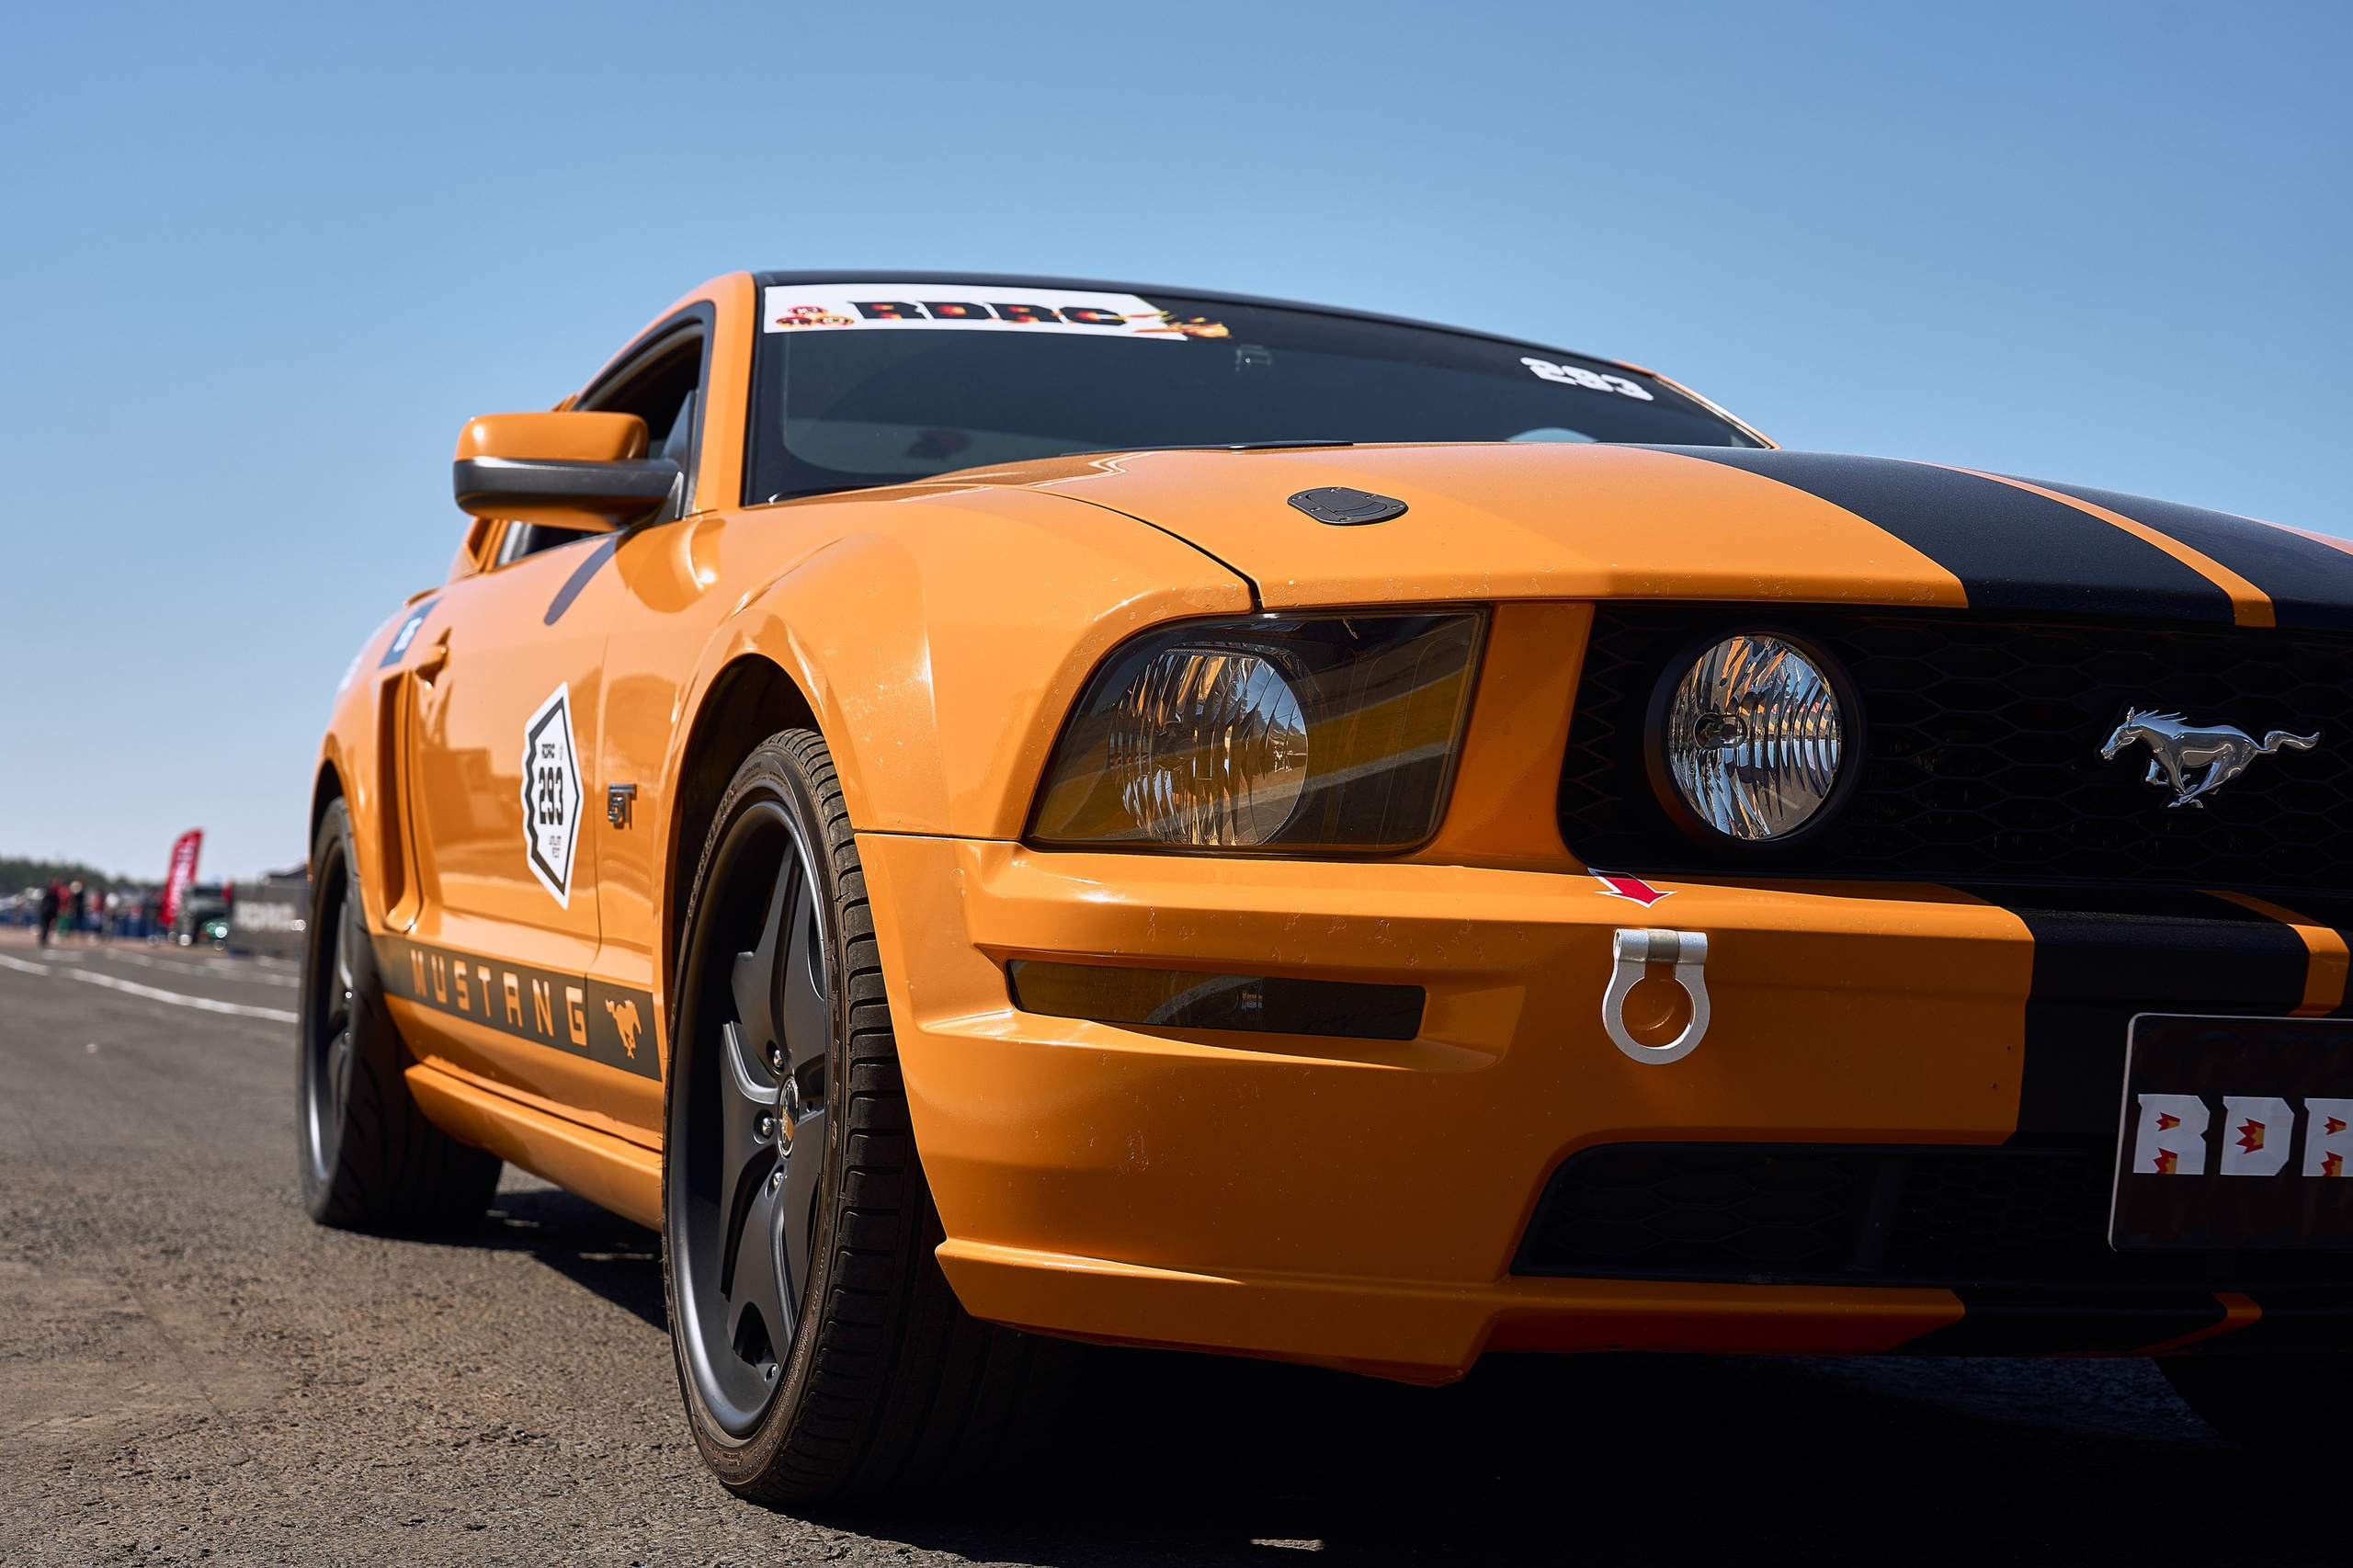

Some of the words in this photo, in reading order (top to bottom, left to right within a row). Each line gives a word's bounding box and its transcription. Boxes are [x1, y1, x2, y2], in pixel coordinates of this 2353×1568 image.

[1519, 356, 1655, 402] 293
[539, 767, 563, 825] 293
[608, 783, 633, 824] GT
[410, 949, 588, 1047] MUSTANG
